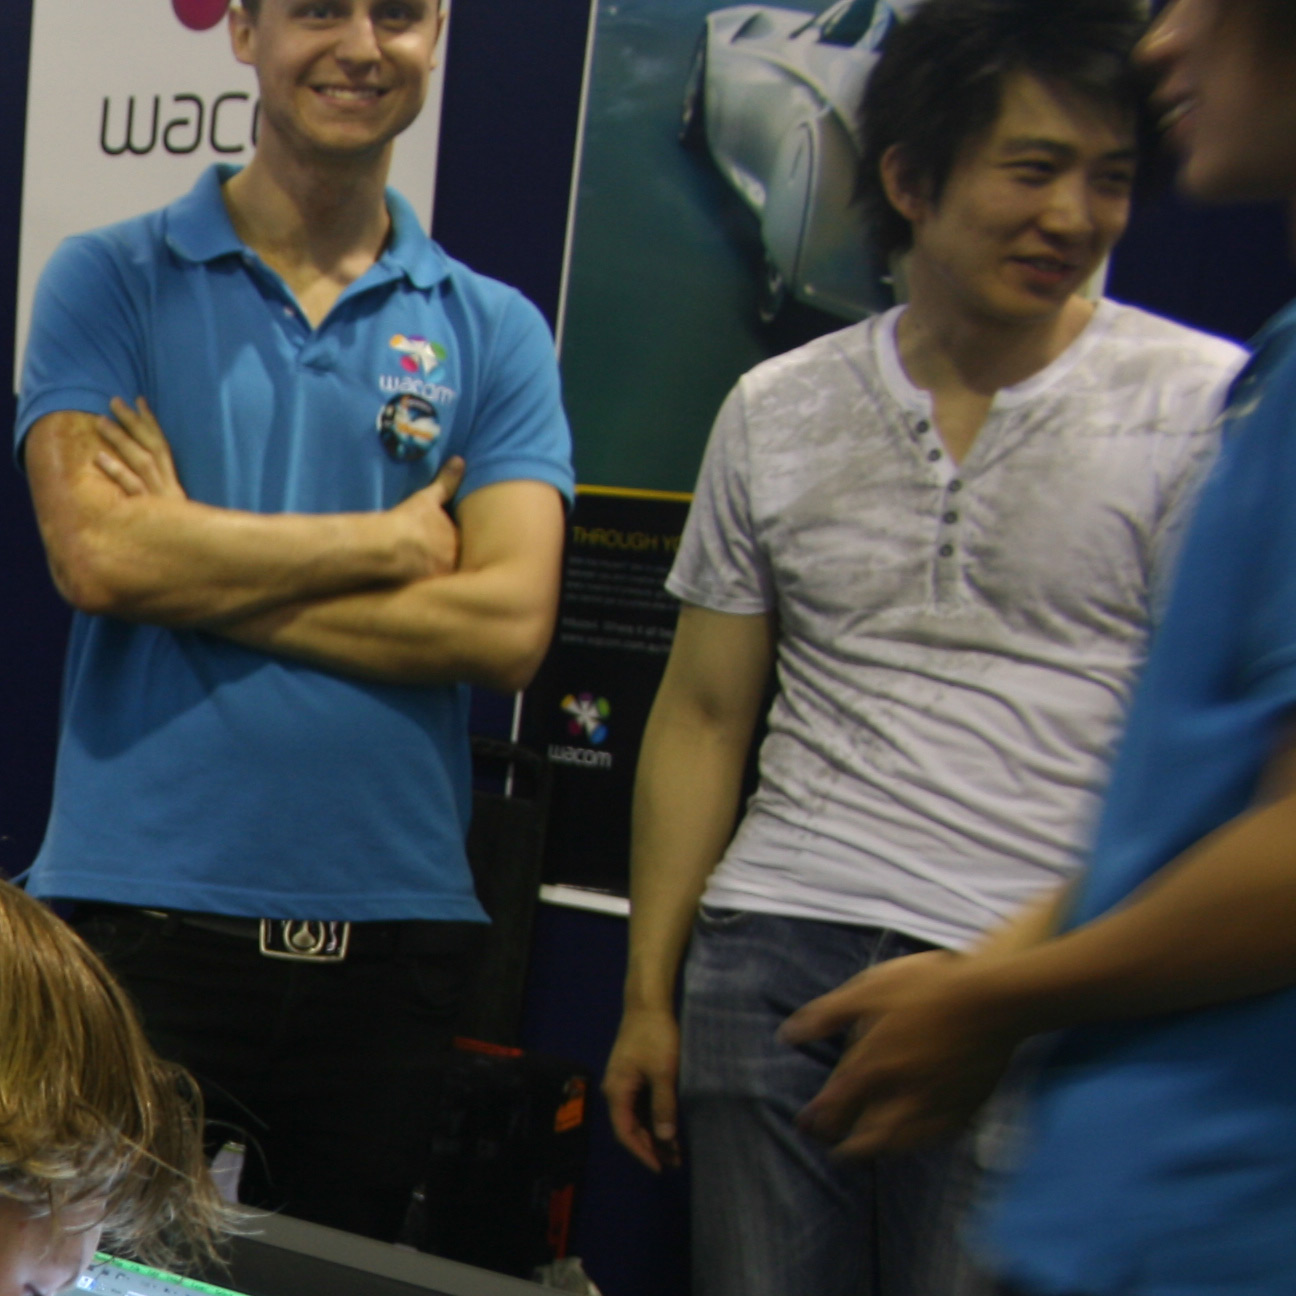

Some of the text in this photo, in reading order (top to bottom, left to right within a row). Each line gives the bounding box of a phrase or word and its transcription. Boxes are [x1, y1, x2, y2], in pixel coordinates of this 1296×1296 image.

[100, 91, 260, 155] wac
[378, 374, 458, 405] wacom
[548, 745, 612, 769] wacom
